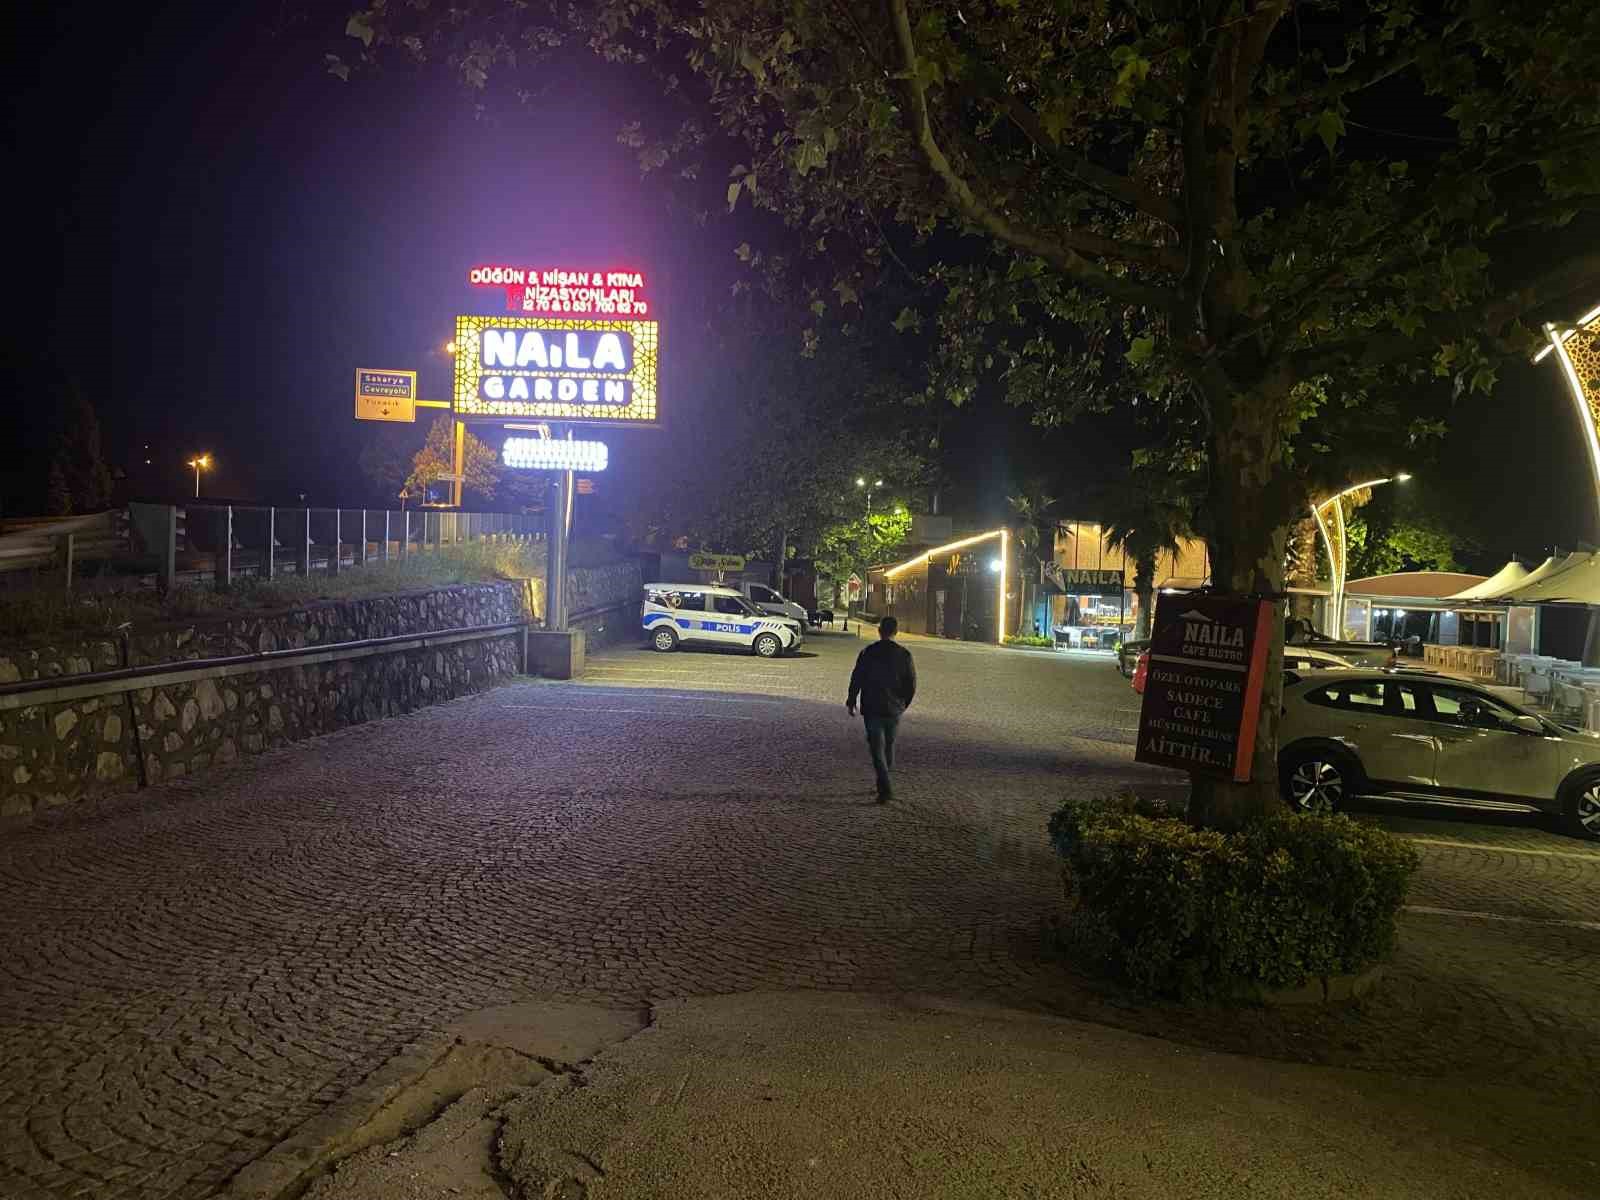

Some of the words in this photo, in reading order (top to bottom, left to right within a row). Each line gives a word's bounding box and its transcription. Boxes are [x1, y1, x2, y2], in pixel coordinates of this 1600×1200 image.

[471, 267, 524, 284] DÜĞÜN
[528, 271, 538, 284] &
[543, 268, 588, 287] NİŞAN
[592, 273, 602, 285] &
[607, 272, 643, 288] KINA
[365, 375, 404, 385] Sakarya
[484, 376, 624, 402] GARDEN
[1167, 688, 1224, 710] SADECE
[1173, 706, 1210, 723] CAFE
